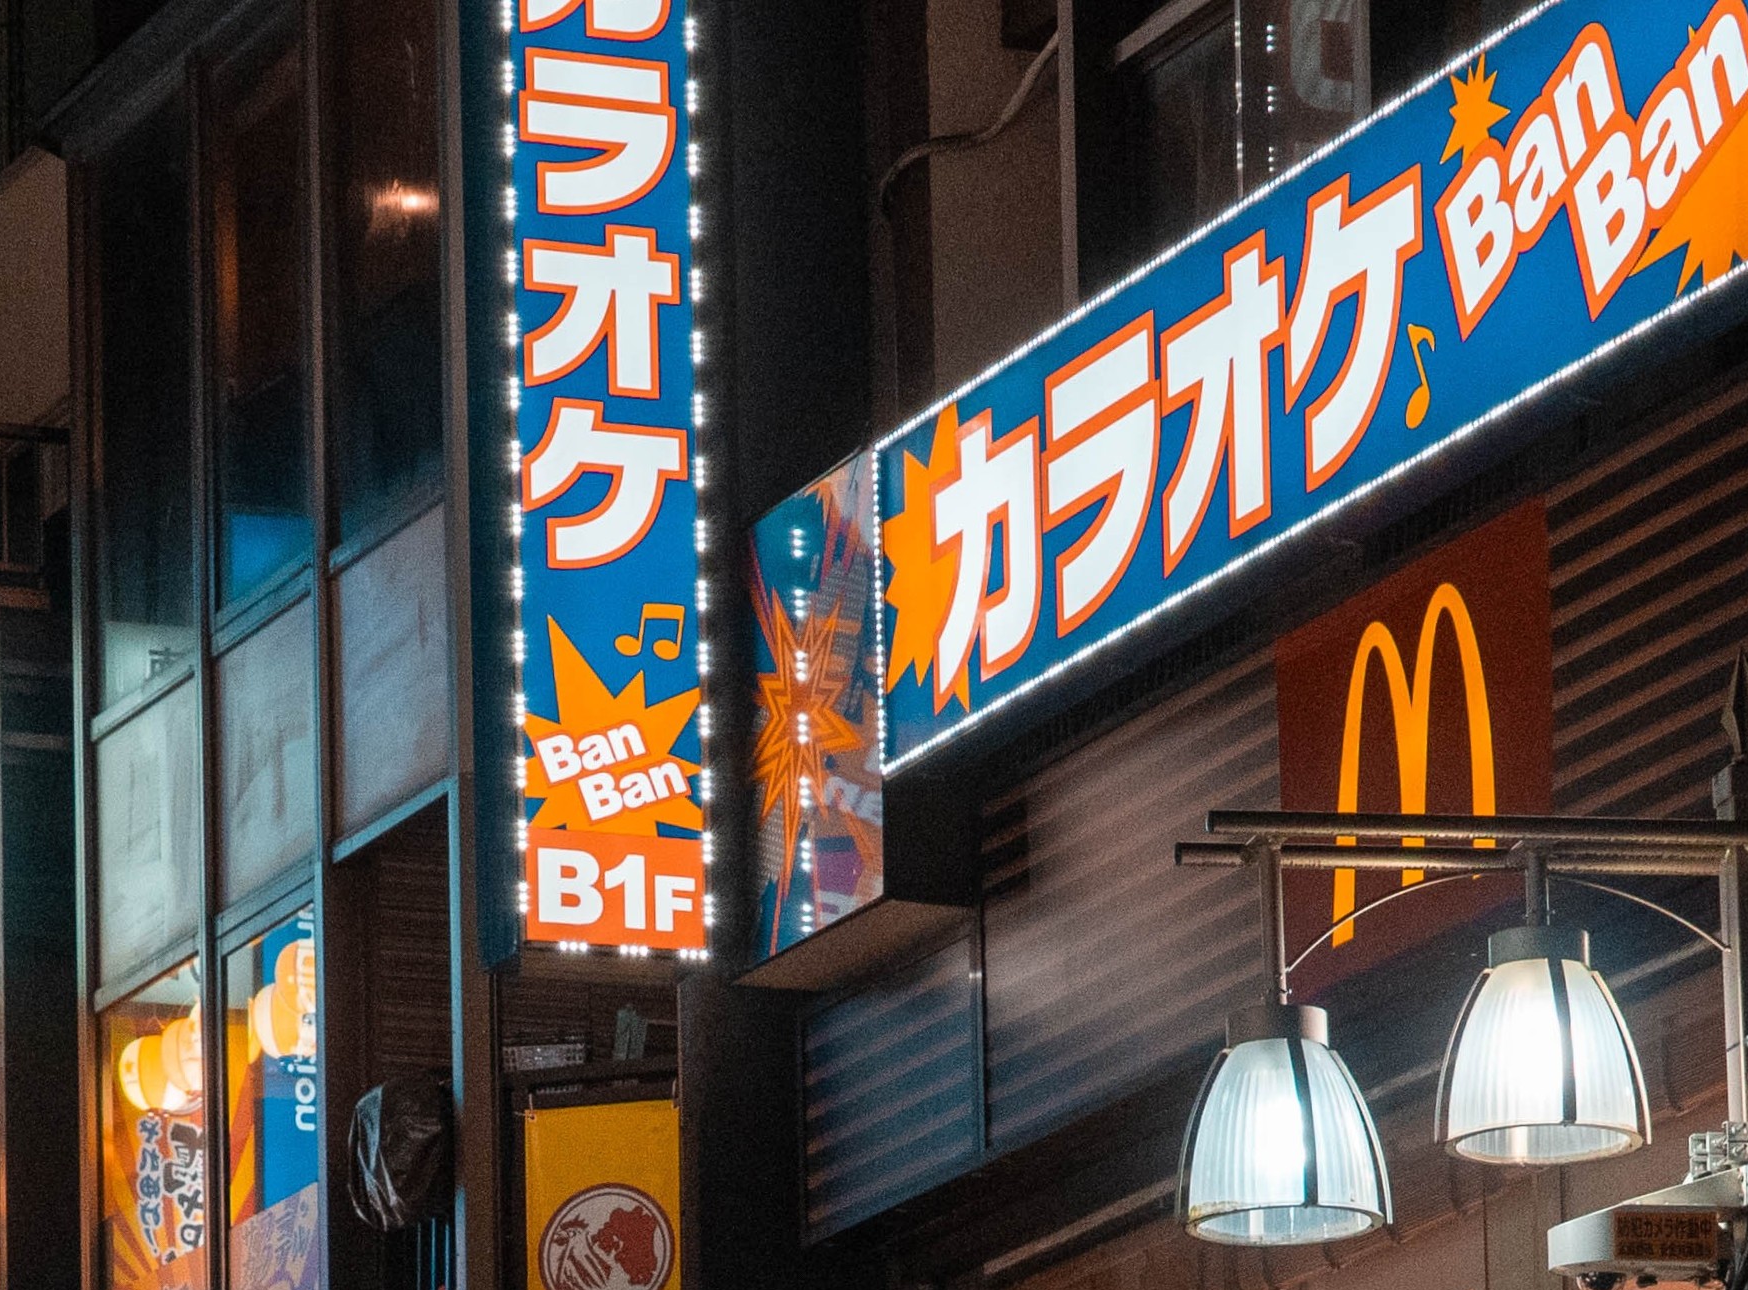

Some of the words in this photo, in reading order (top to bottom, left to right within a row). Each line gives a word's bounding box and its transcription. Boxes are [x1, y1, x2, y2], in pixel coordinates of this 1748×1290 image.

[1441, 34, 1619, 330] Ban
[519, 0, 688, 570] ラオケ
[931, 166, 1422, 711] カラオケ
[537, 719, 650, 786] Ban
[579, 754, 692, 825] Ban
[537, 847, 698, 935] B1F
